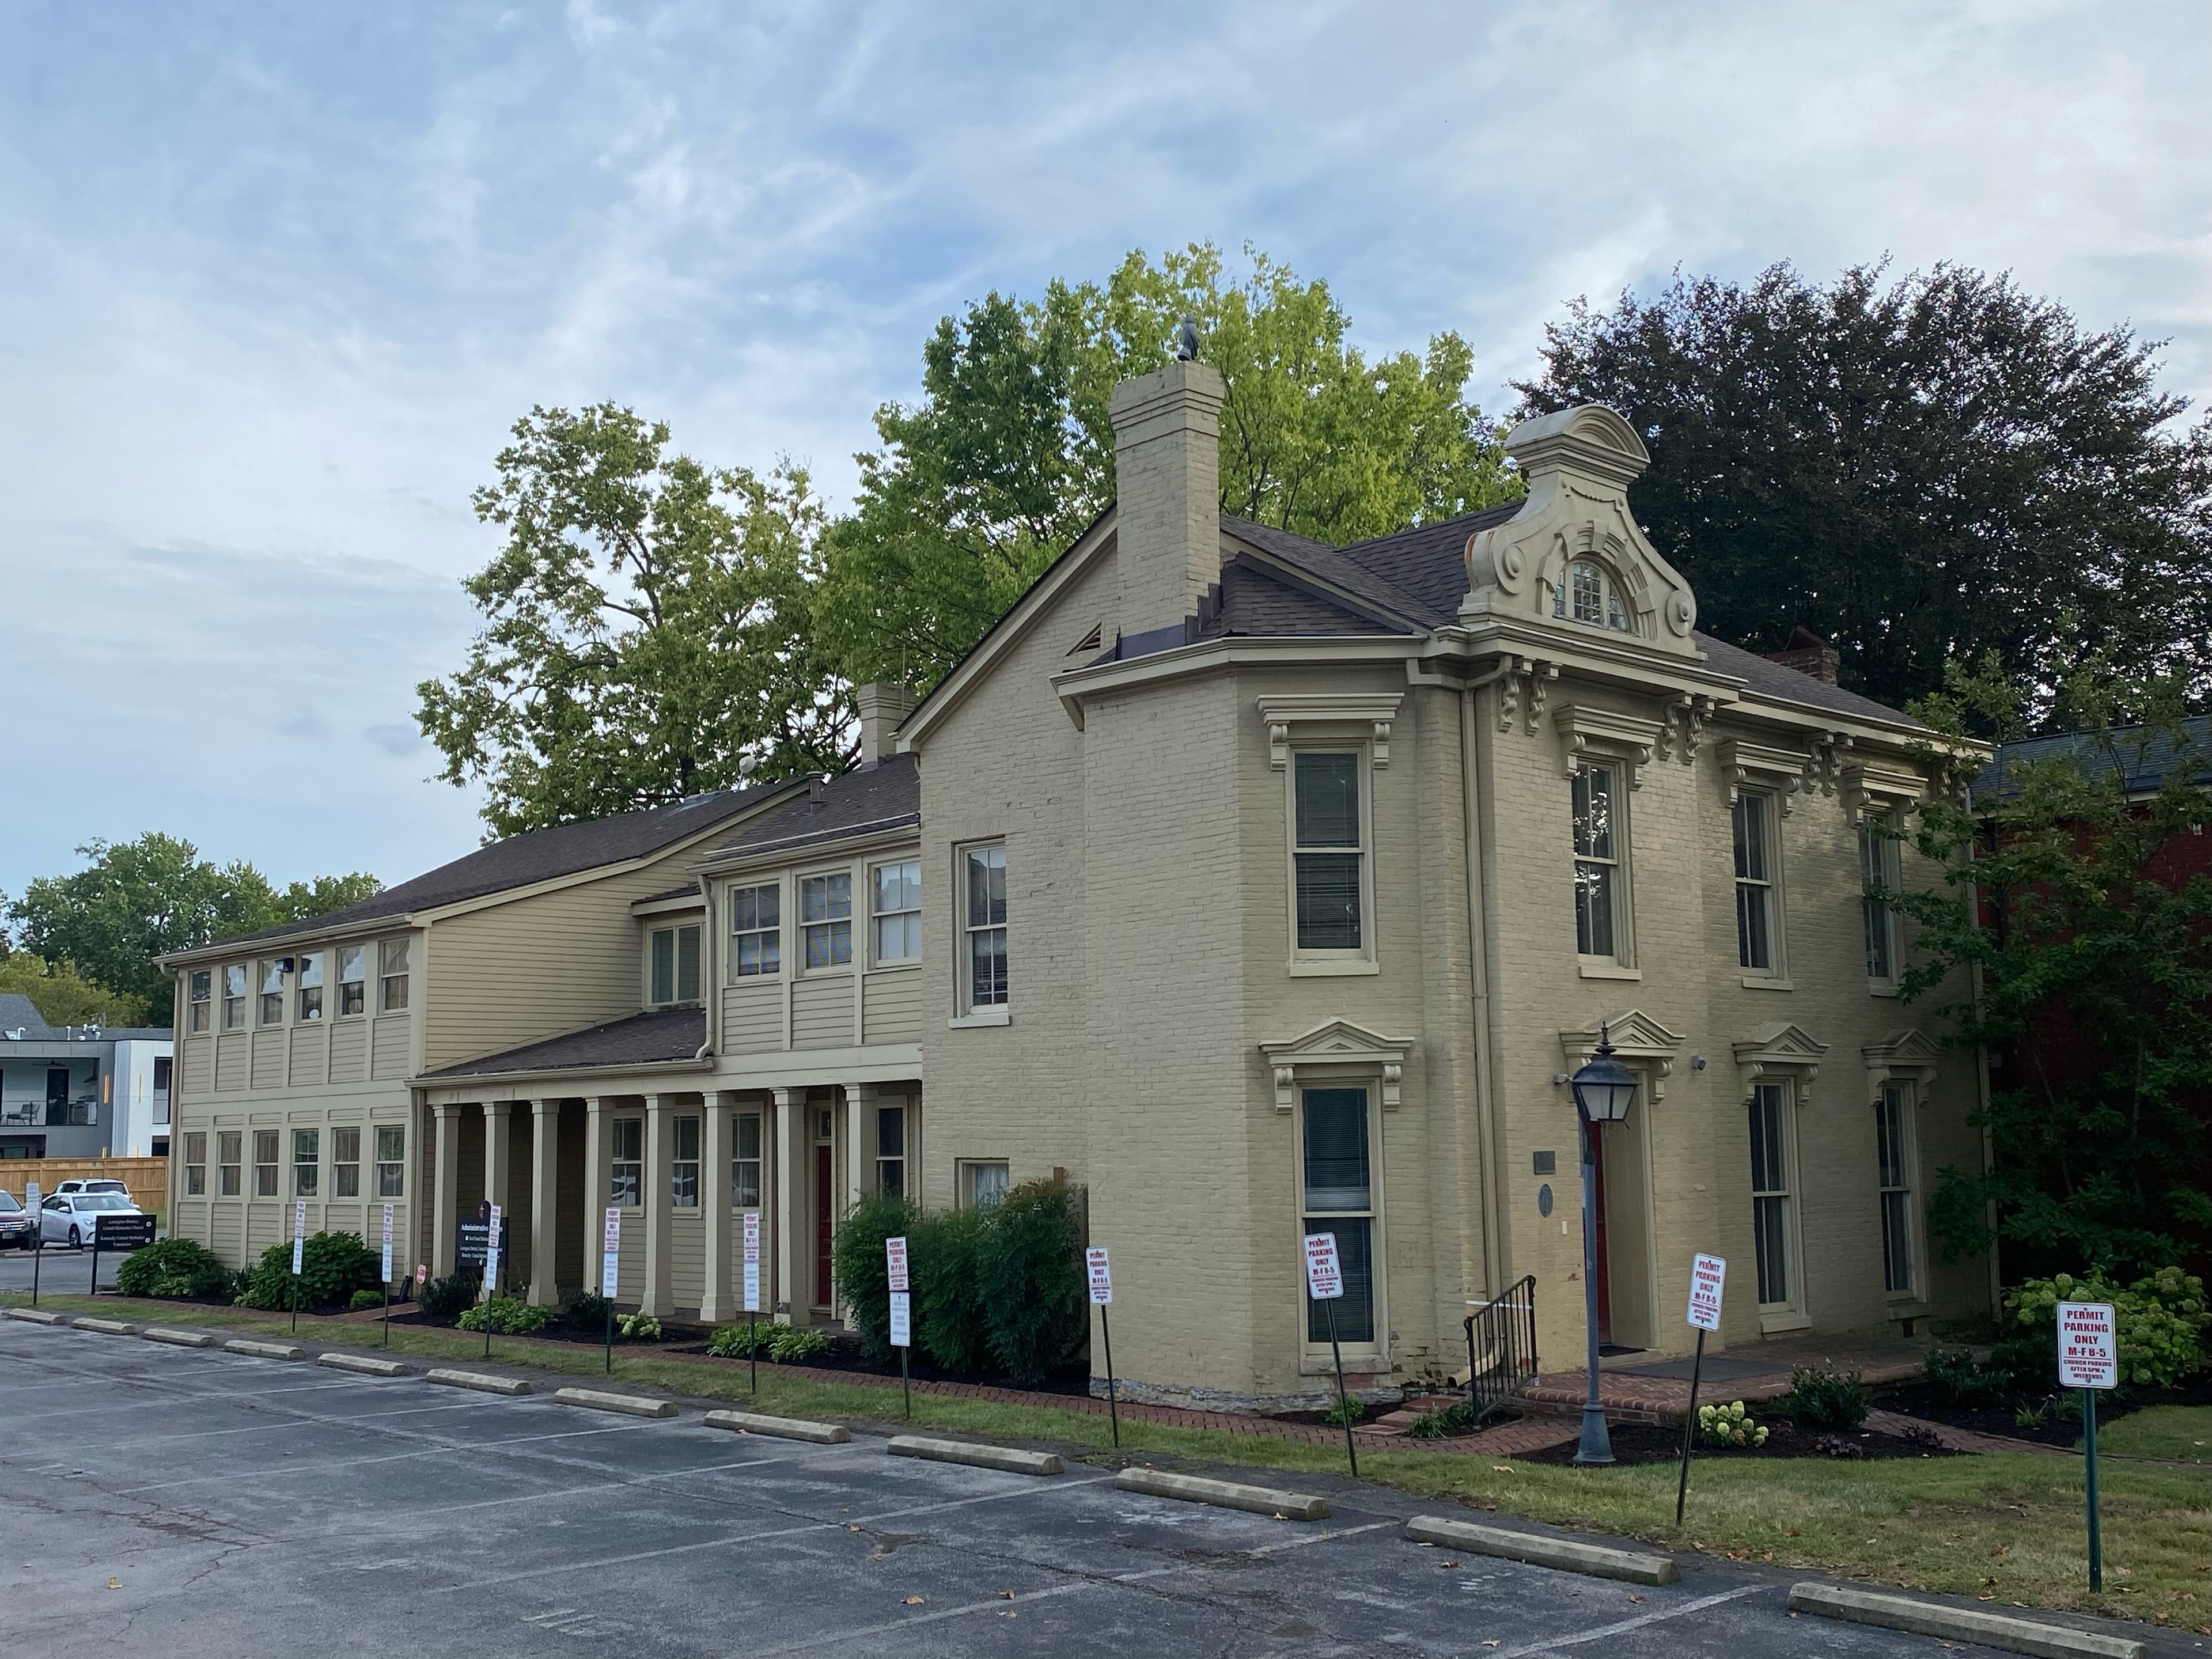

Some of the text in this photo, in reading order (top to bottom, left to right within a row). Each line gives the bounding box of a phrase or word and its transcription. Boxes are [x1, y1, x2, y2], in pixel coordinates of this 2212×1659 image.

[1309, 1239, 1330, 1247] PERMIT
[1309, 1248, 1333, 1257] PARKING
[1699, 1260, 1720, 1272] PERMIT
[1696, 1271, 1720, 1283] PARKING
[1700, 1282, 1714, 1292] ONLY
[2067, 1310, 2104, 1320] PERMIT
[2065, 1323, 2108, 1332] PARKING
[2075, 1335, 2099, 1344] ONLY
[2069, 1347, 2106, 1357] M-F 8-5
